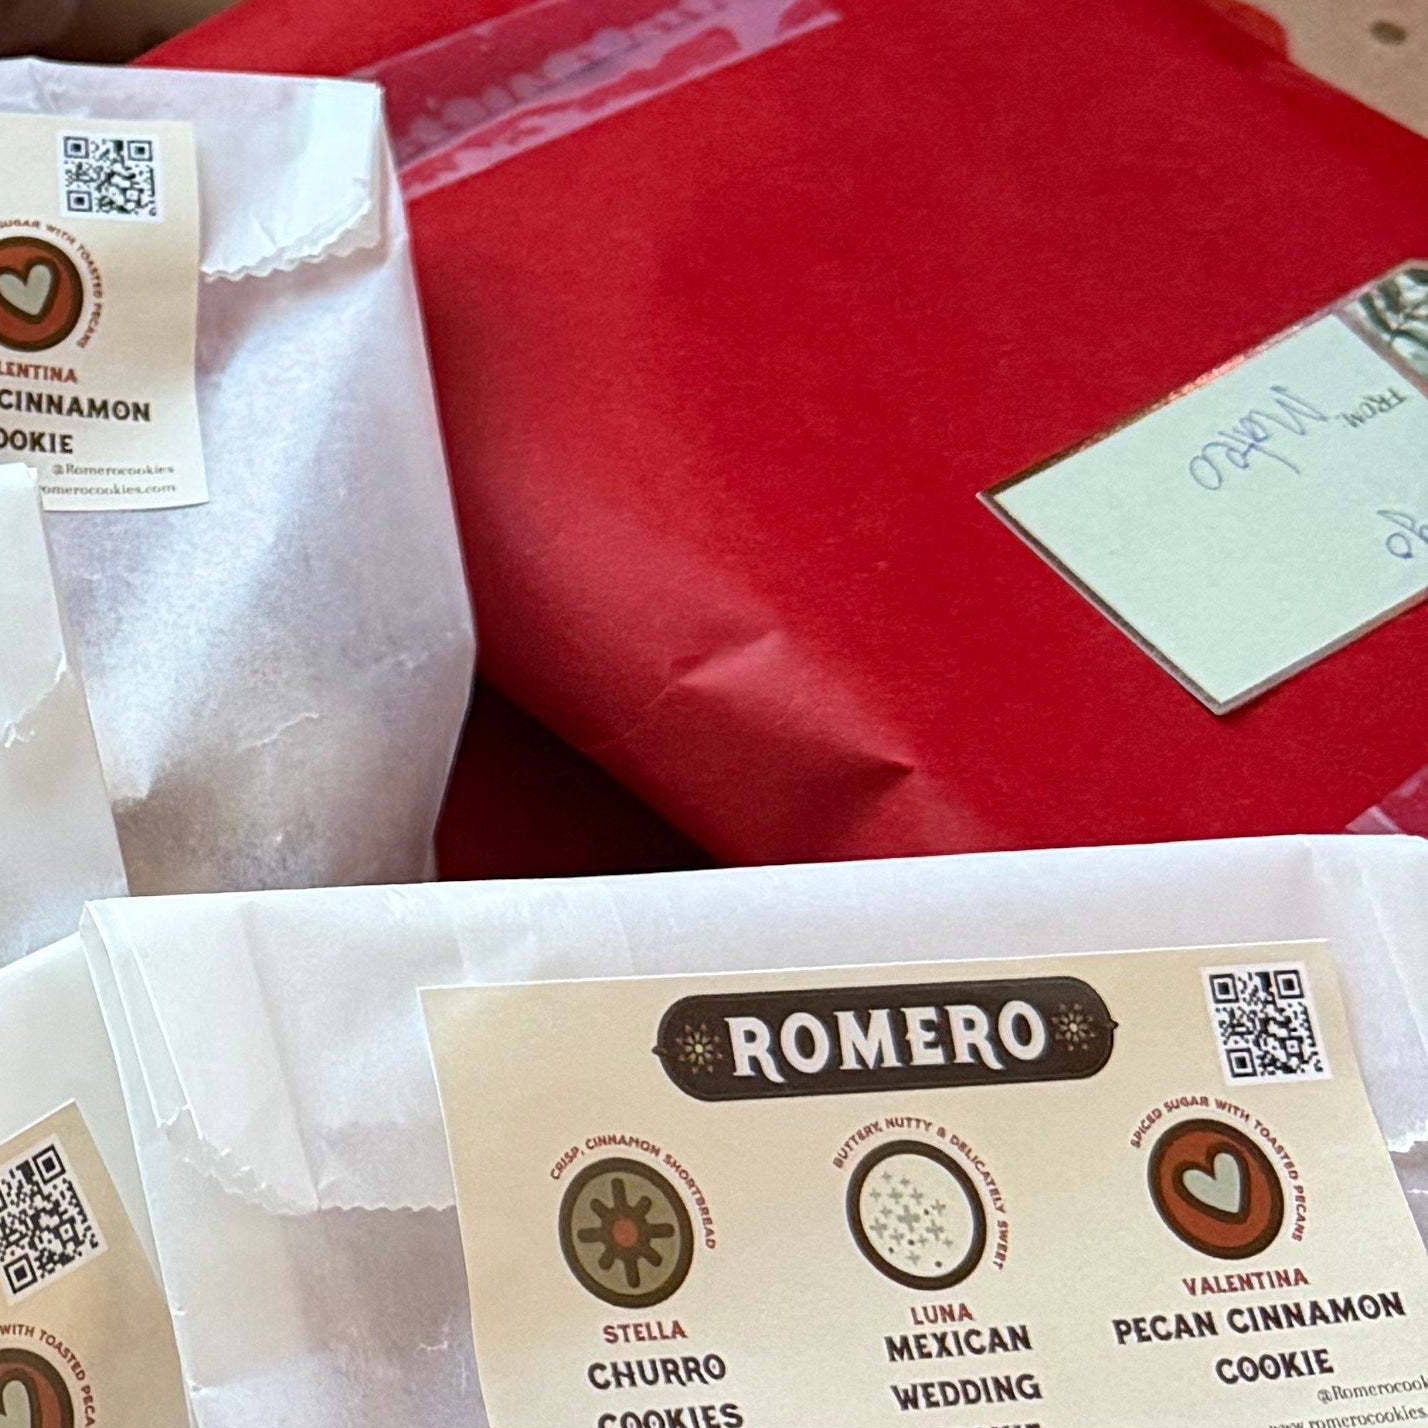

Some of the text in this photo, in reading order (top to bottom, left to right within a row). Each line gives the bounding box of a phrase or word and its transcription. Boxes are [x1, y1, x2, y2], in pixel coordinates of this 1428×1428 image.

[40, 483, 176, 495] omerocookies.com
[723, 998, 1050, 1085] ROMERO
[1182, 1268, 1309, 1296] VALENTINA
[601, 1320, 688, 1344] STELLA
[909, 1302, 975, 1326] LUNA
[1111, 1292, 1406, 1345] PECAN CINNAMON
[38, 1328, 87, 1382] TOASTED
[884, 1324, 1034, 1363] MEXICAN
[587, 1353, 727, 1389] CHURRO
[1216, 1348, 1334, 1384] COOKIE
[889, 1372, 1045, 1412] WEDDING
[1317, 1375, 1428, 1405] @Romerocook
